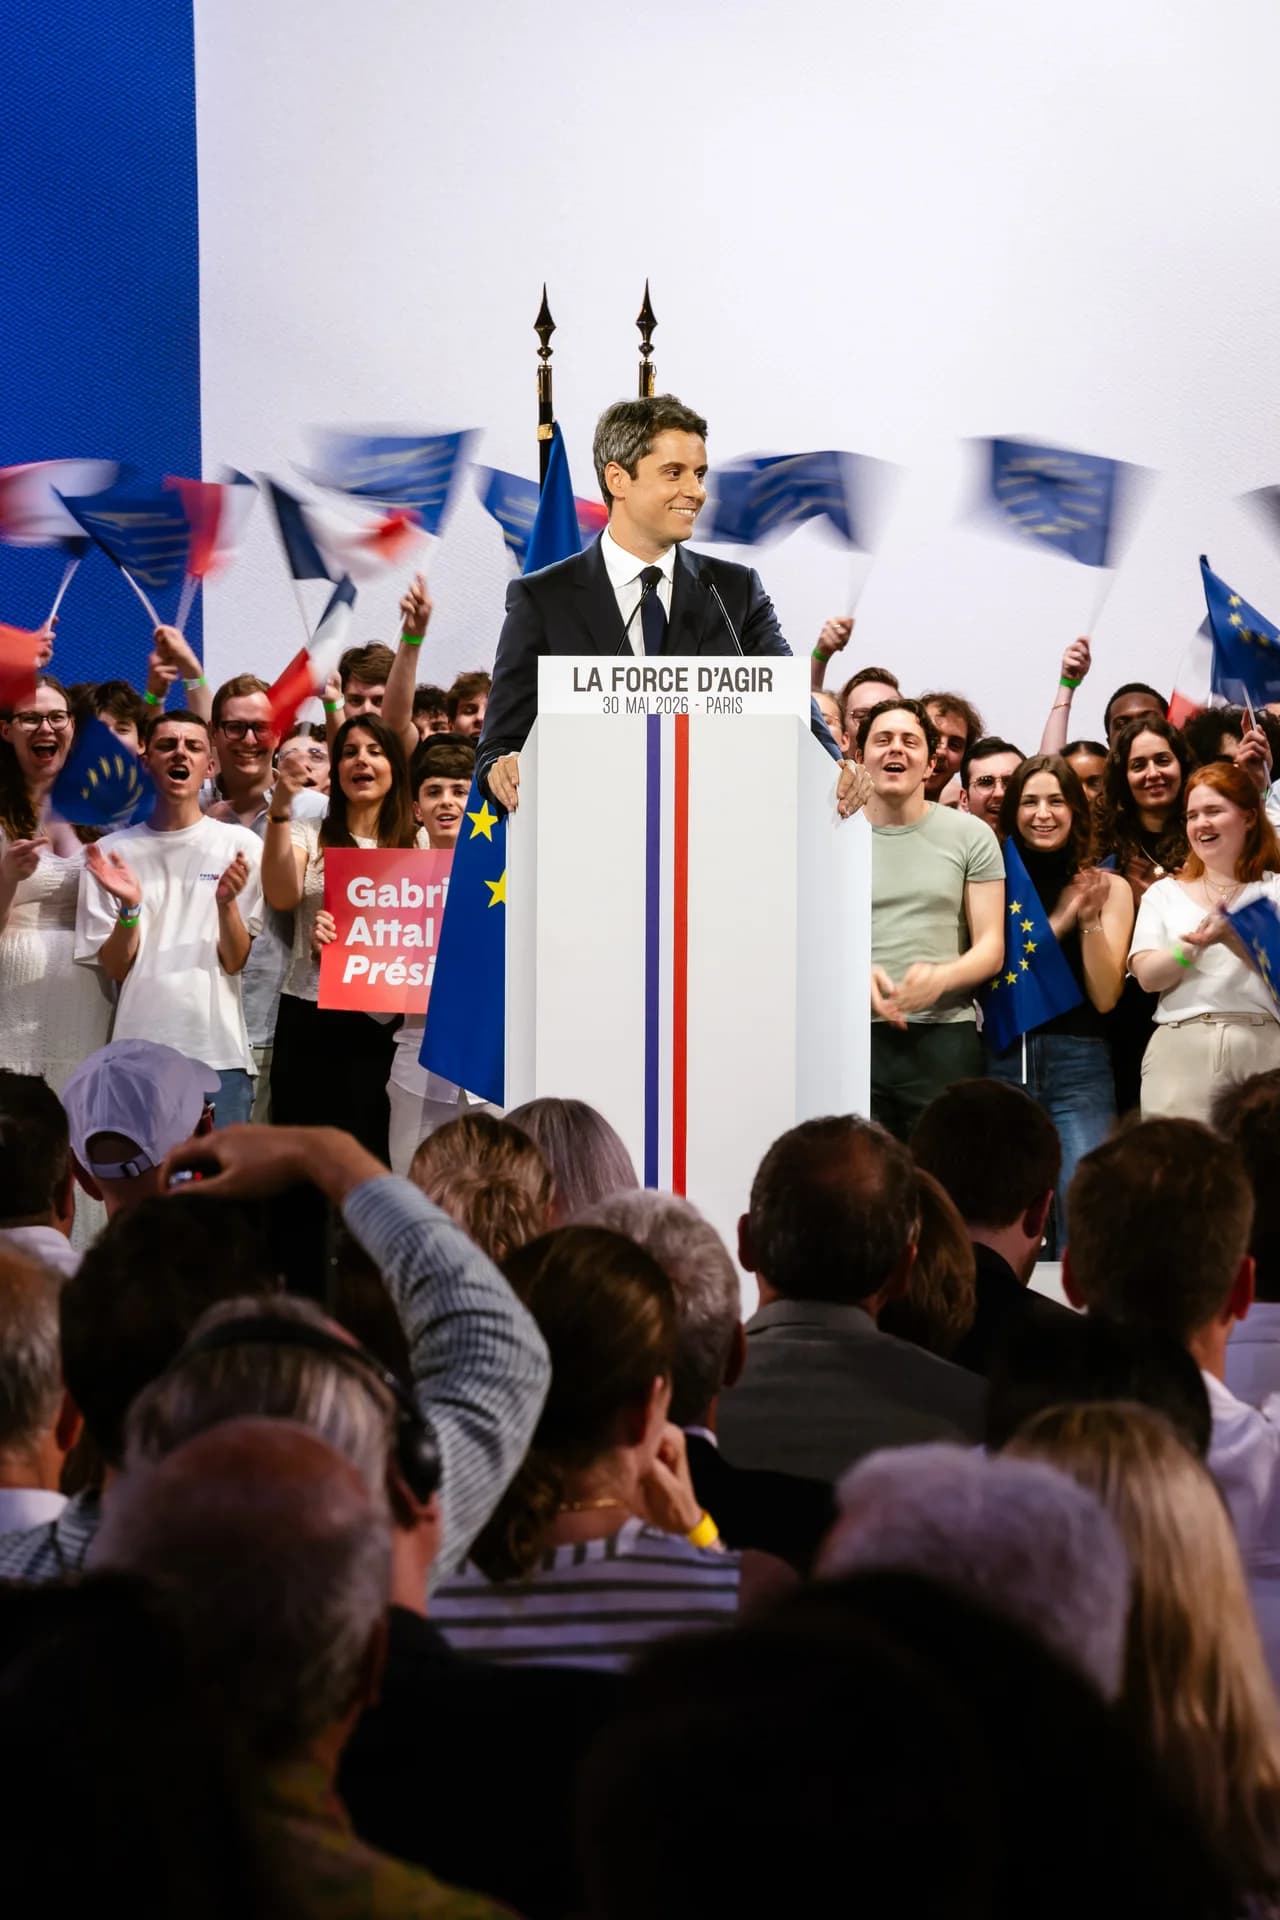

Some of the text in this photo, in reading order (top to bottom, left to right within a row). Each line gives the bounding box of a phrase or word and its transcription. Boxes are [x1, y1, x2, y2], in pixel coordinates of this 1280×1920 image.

[573, 667, 773, 692] LA FORCE D’AGIR
[603, 697, 619, 714] 30
[626, 697, 650, 714] MAI
[656, 697, 688, 714] 2026
[706, 697, 743, 714] PARIS
[345, 916, 435, 947] Attal
